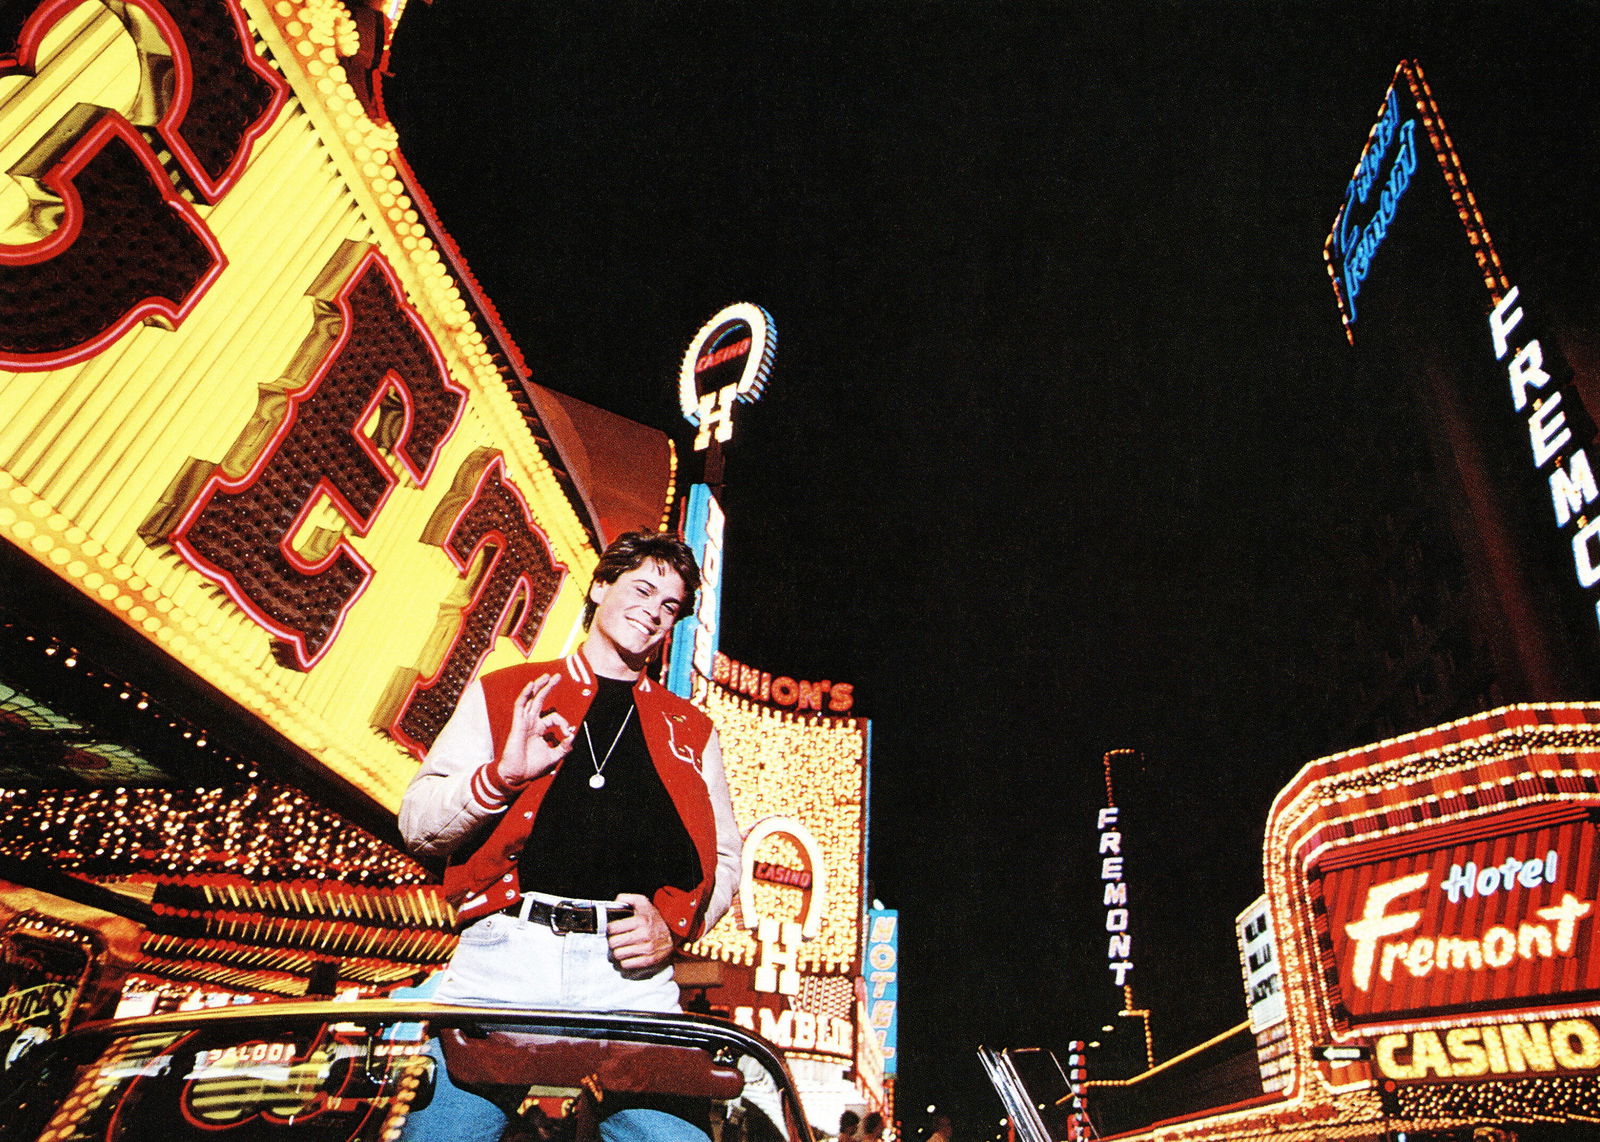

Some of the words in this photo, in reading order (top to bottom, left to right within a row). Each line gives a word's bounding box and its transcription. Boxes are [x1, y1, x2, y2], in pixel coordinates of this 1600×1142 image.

[694, 336, 752, 373] CASINO
[1489, 284, 1600, 632] FREMO
[712, 650, 854, 711] BINION'S
[755, 863, 812, 889] CASINO
[1097, 806, 1134, 987] FREMONT
[1440, 850, 1558, 904] Hotel
[1345, 871, 1591, 992] Fremont
[869, 916, 898, 1059] HOTEL
[1375, 1018, 1600, 1081] CASINO
